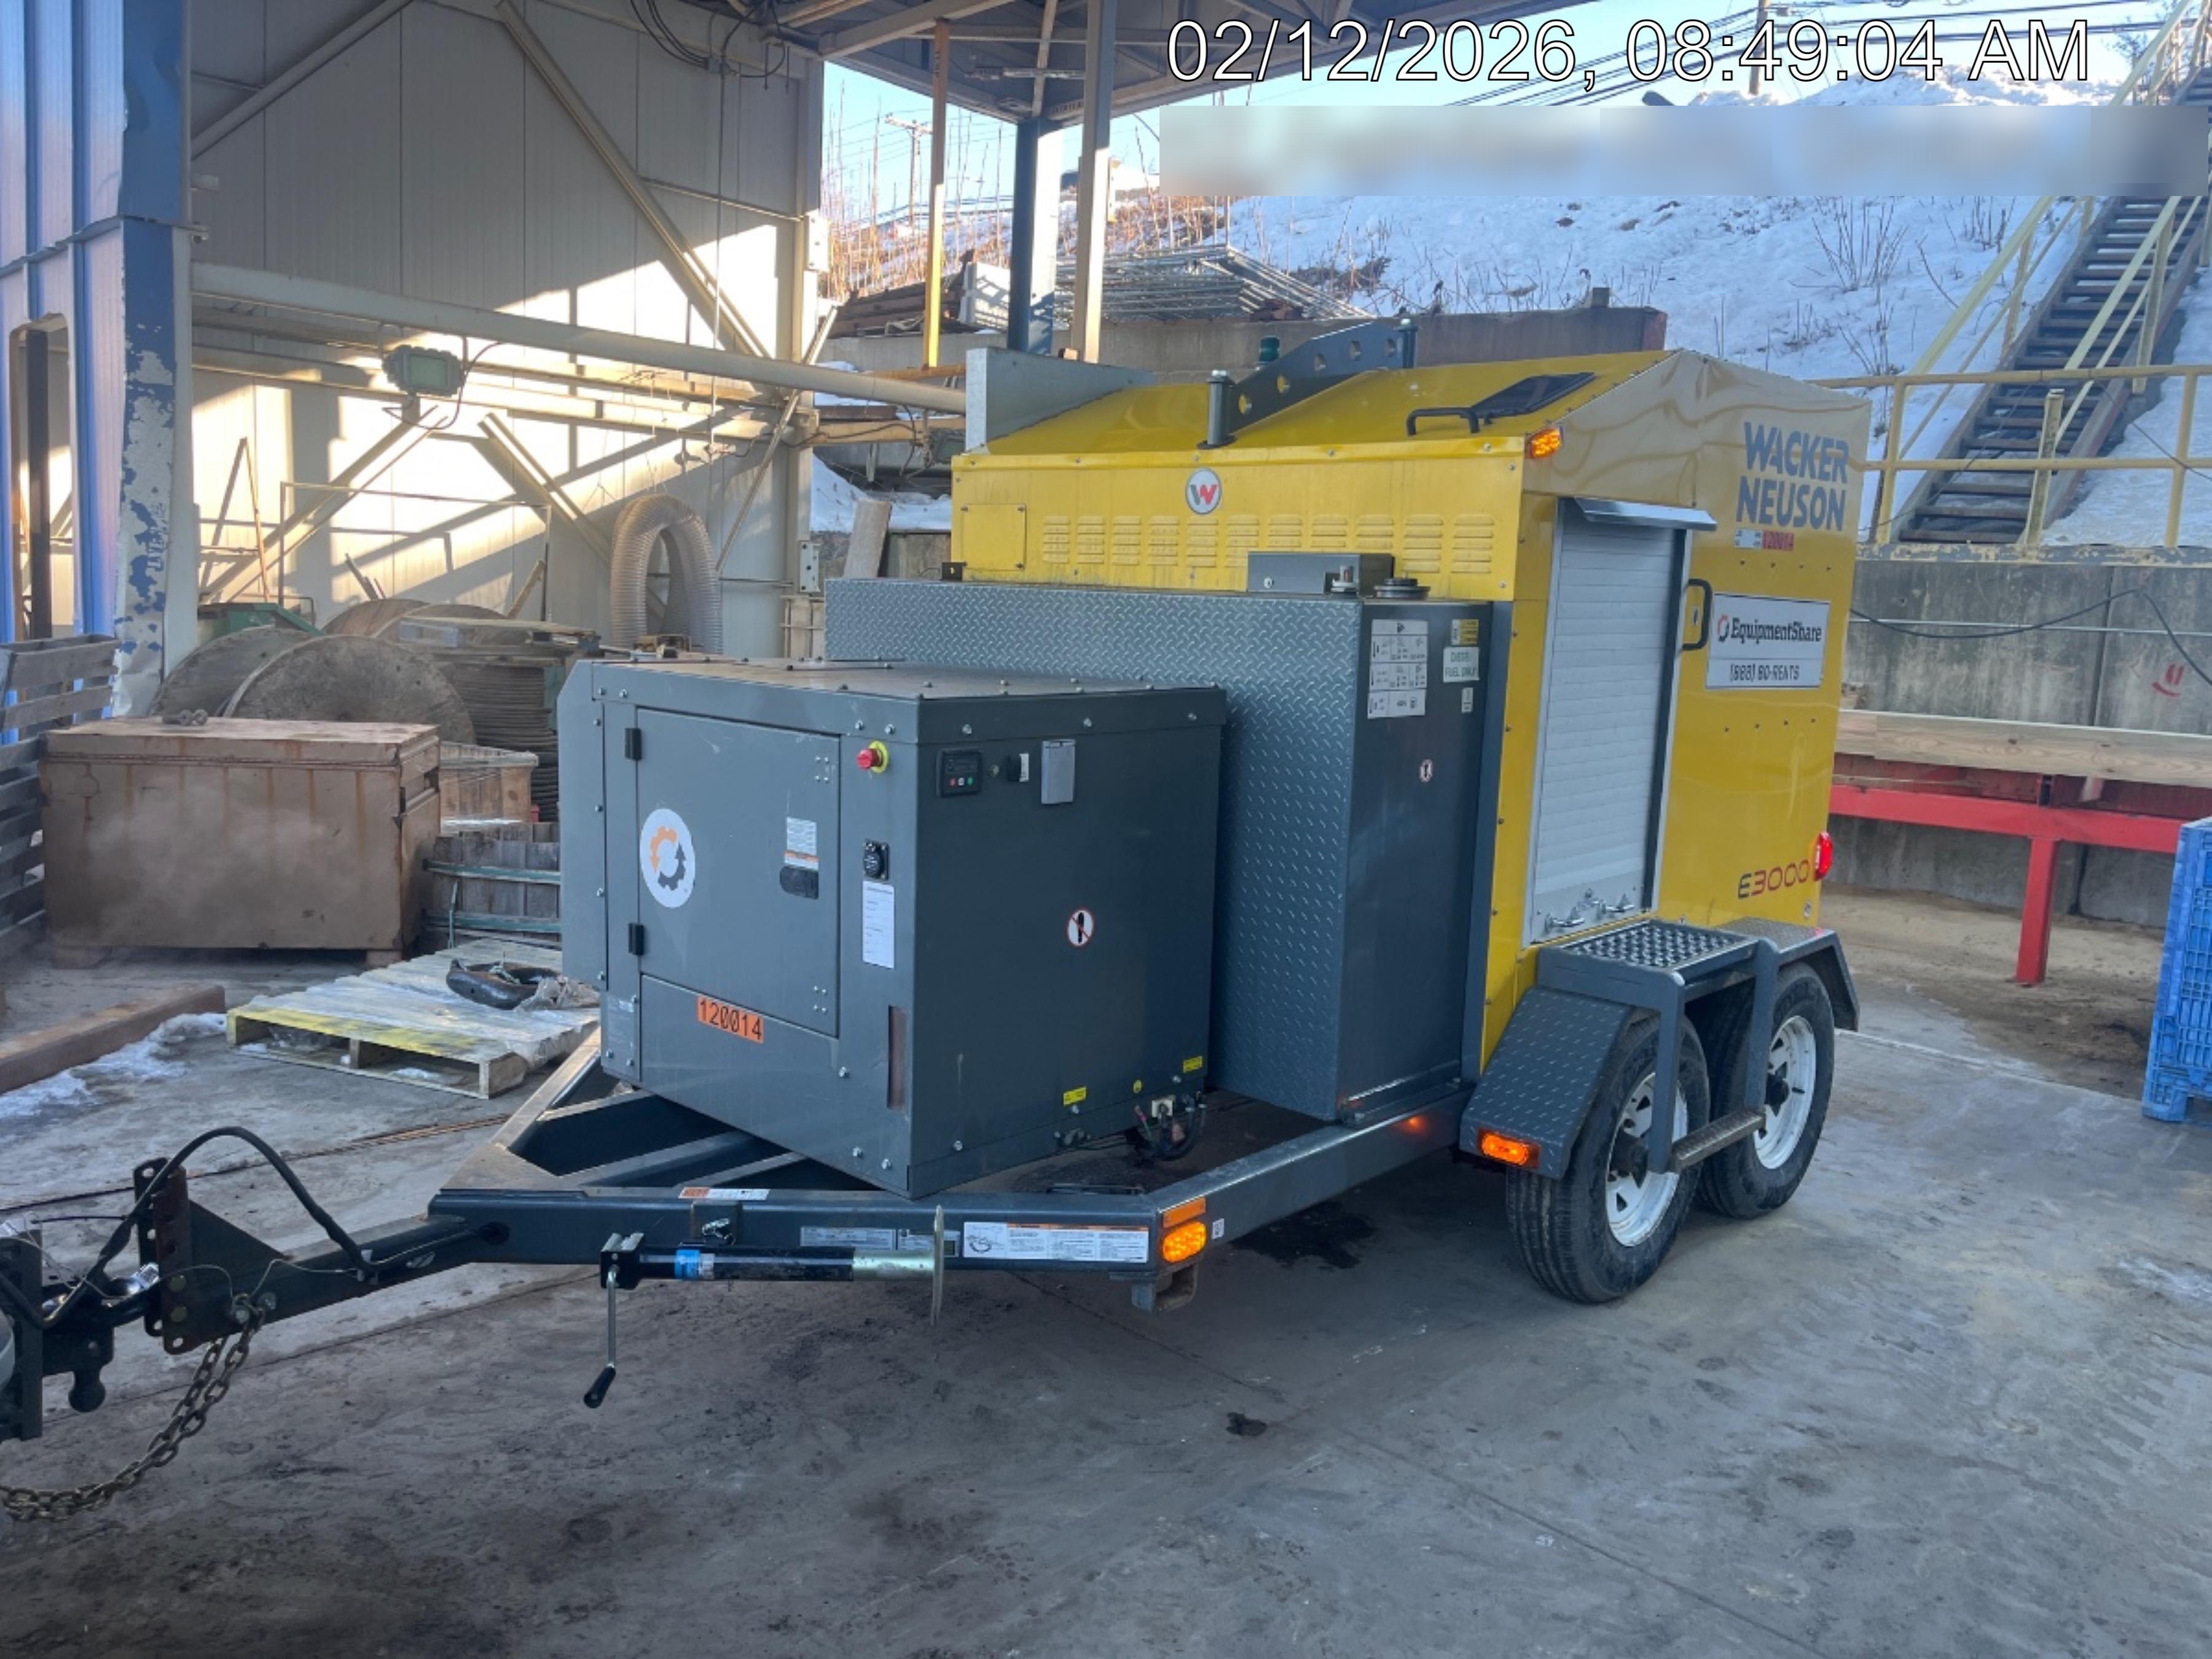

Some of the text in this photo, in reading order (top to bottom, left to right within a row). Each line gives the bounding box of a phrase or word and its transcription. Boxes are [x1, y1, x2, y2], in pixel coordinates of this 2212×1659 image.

[1744, 422, 1849, 484] WACKER
[1736, 475, 1846, 531] NEUSON
[1730, 617, 1822, 645] EquipmentShare
[1738, 859, 1810, 899] E3000
[700, 998, 762, 1041] 120014
